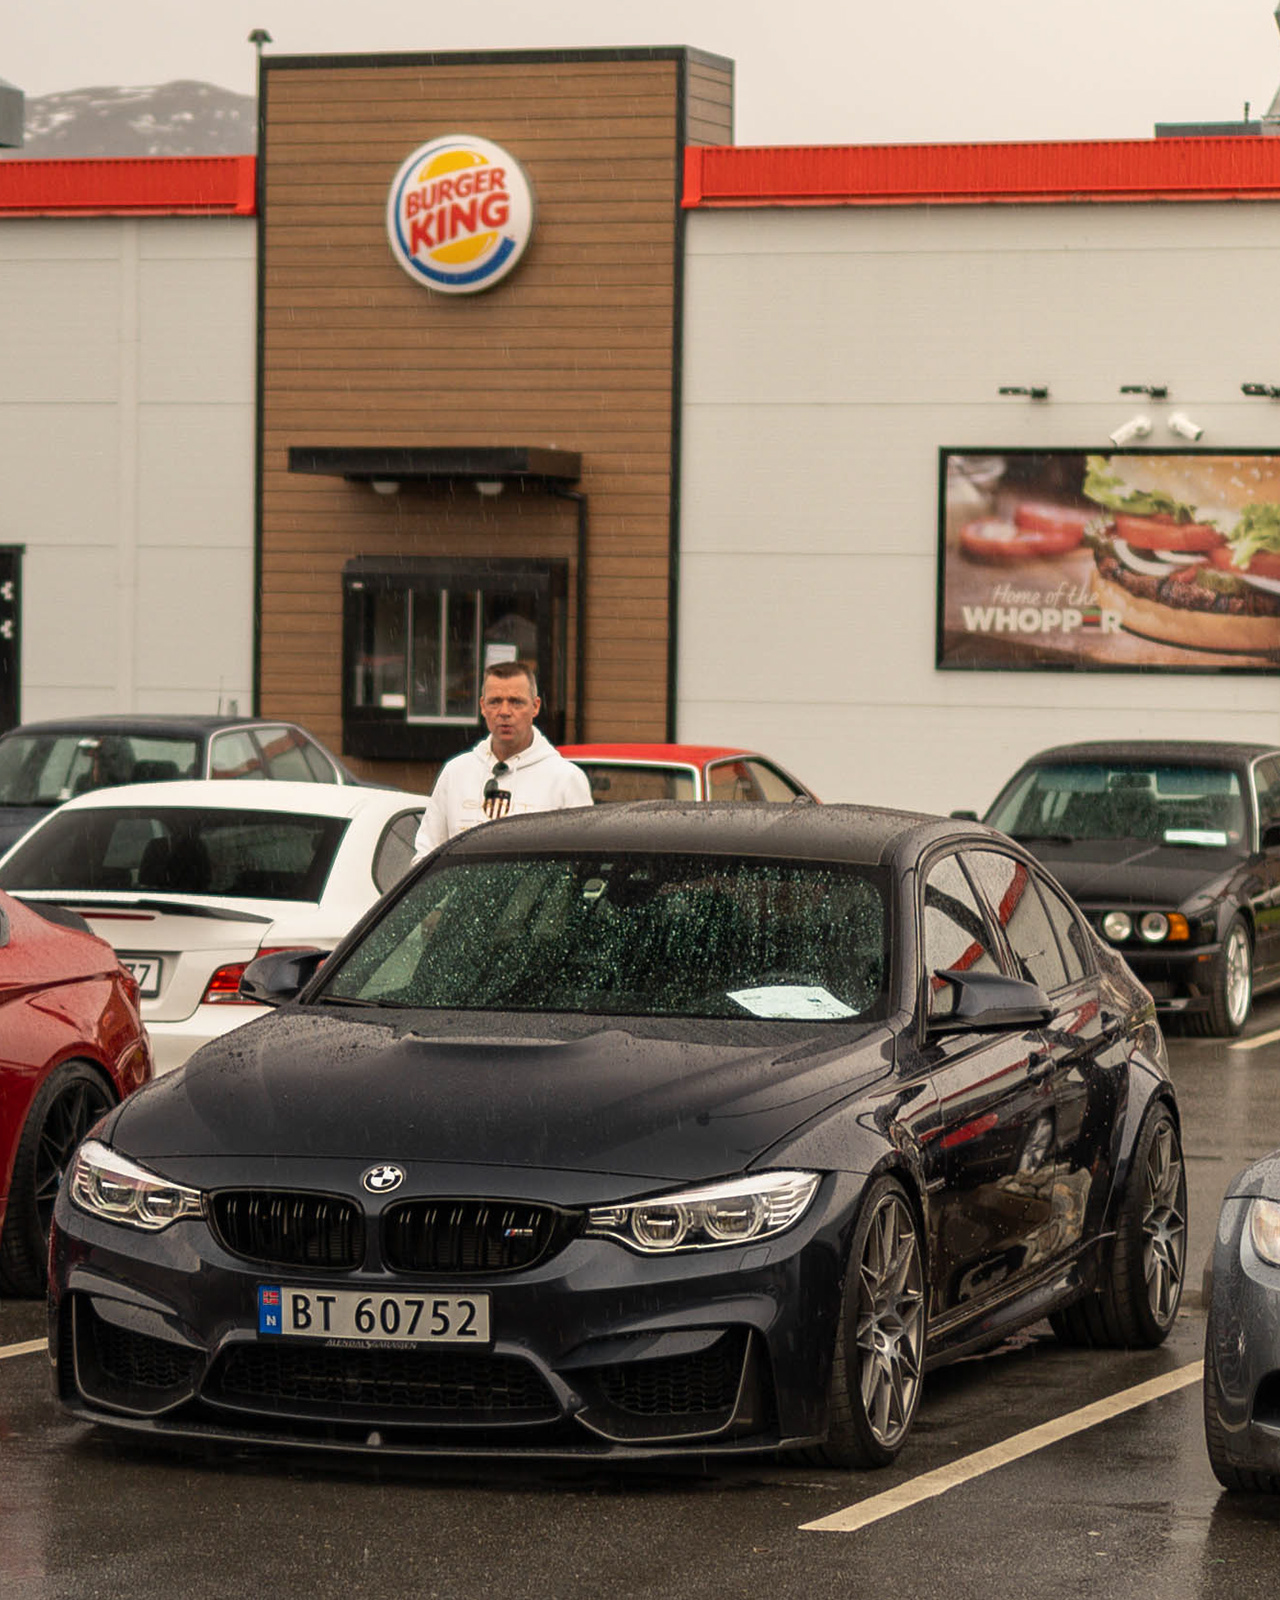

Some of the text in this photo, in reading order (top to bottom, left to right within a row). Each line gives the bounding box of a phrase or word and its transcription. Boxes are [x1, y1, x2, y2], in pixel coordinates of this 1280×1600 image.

[406, 167, 506, 219] BURGER
[410, 191, 510, 256] KING
[992, 581, 1100, 609] Home of the
[266, 1315, 277, 1326] N
[291, 1294, 478, 1336] BT 60752
